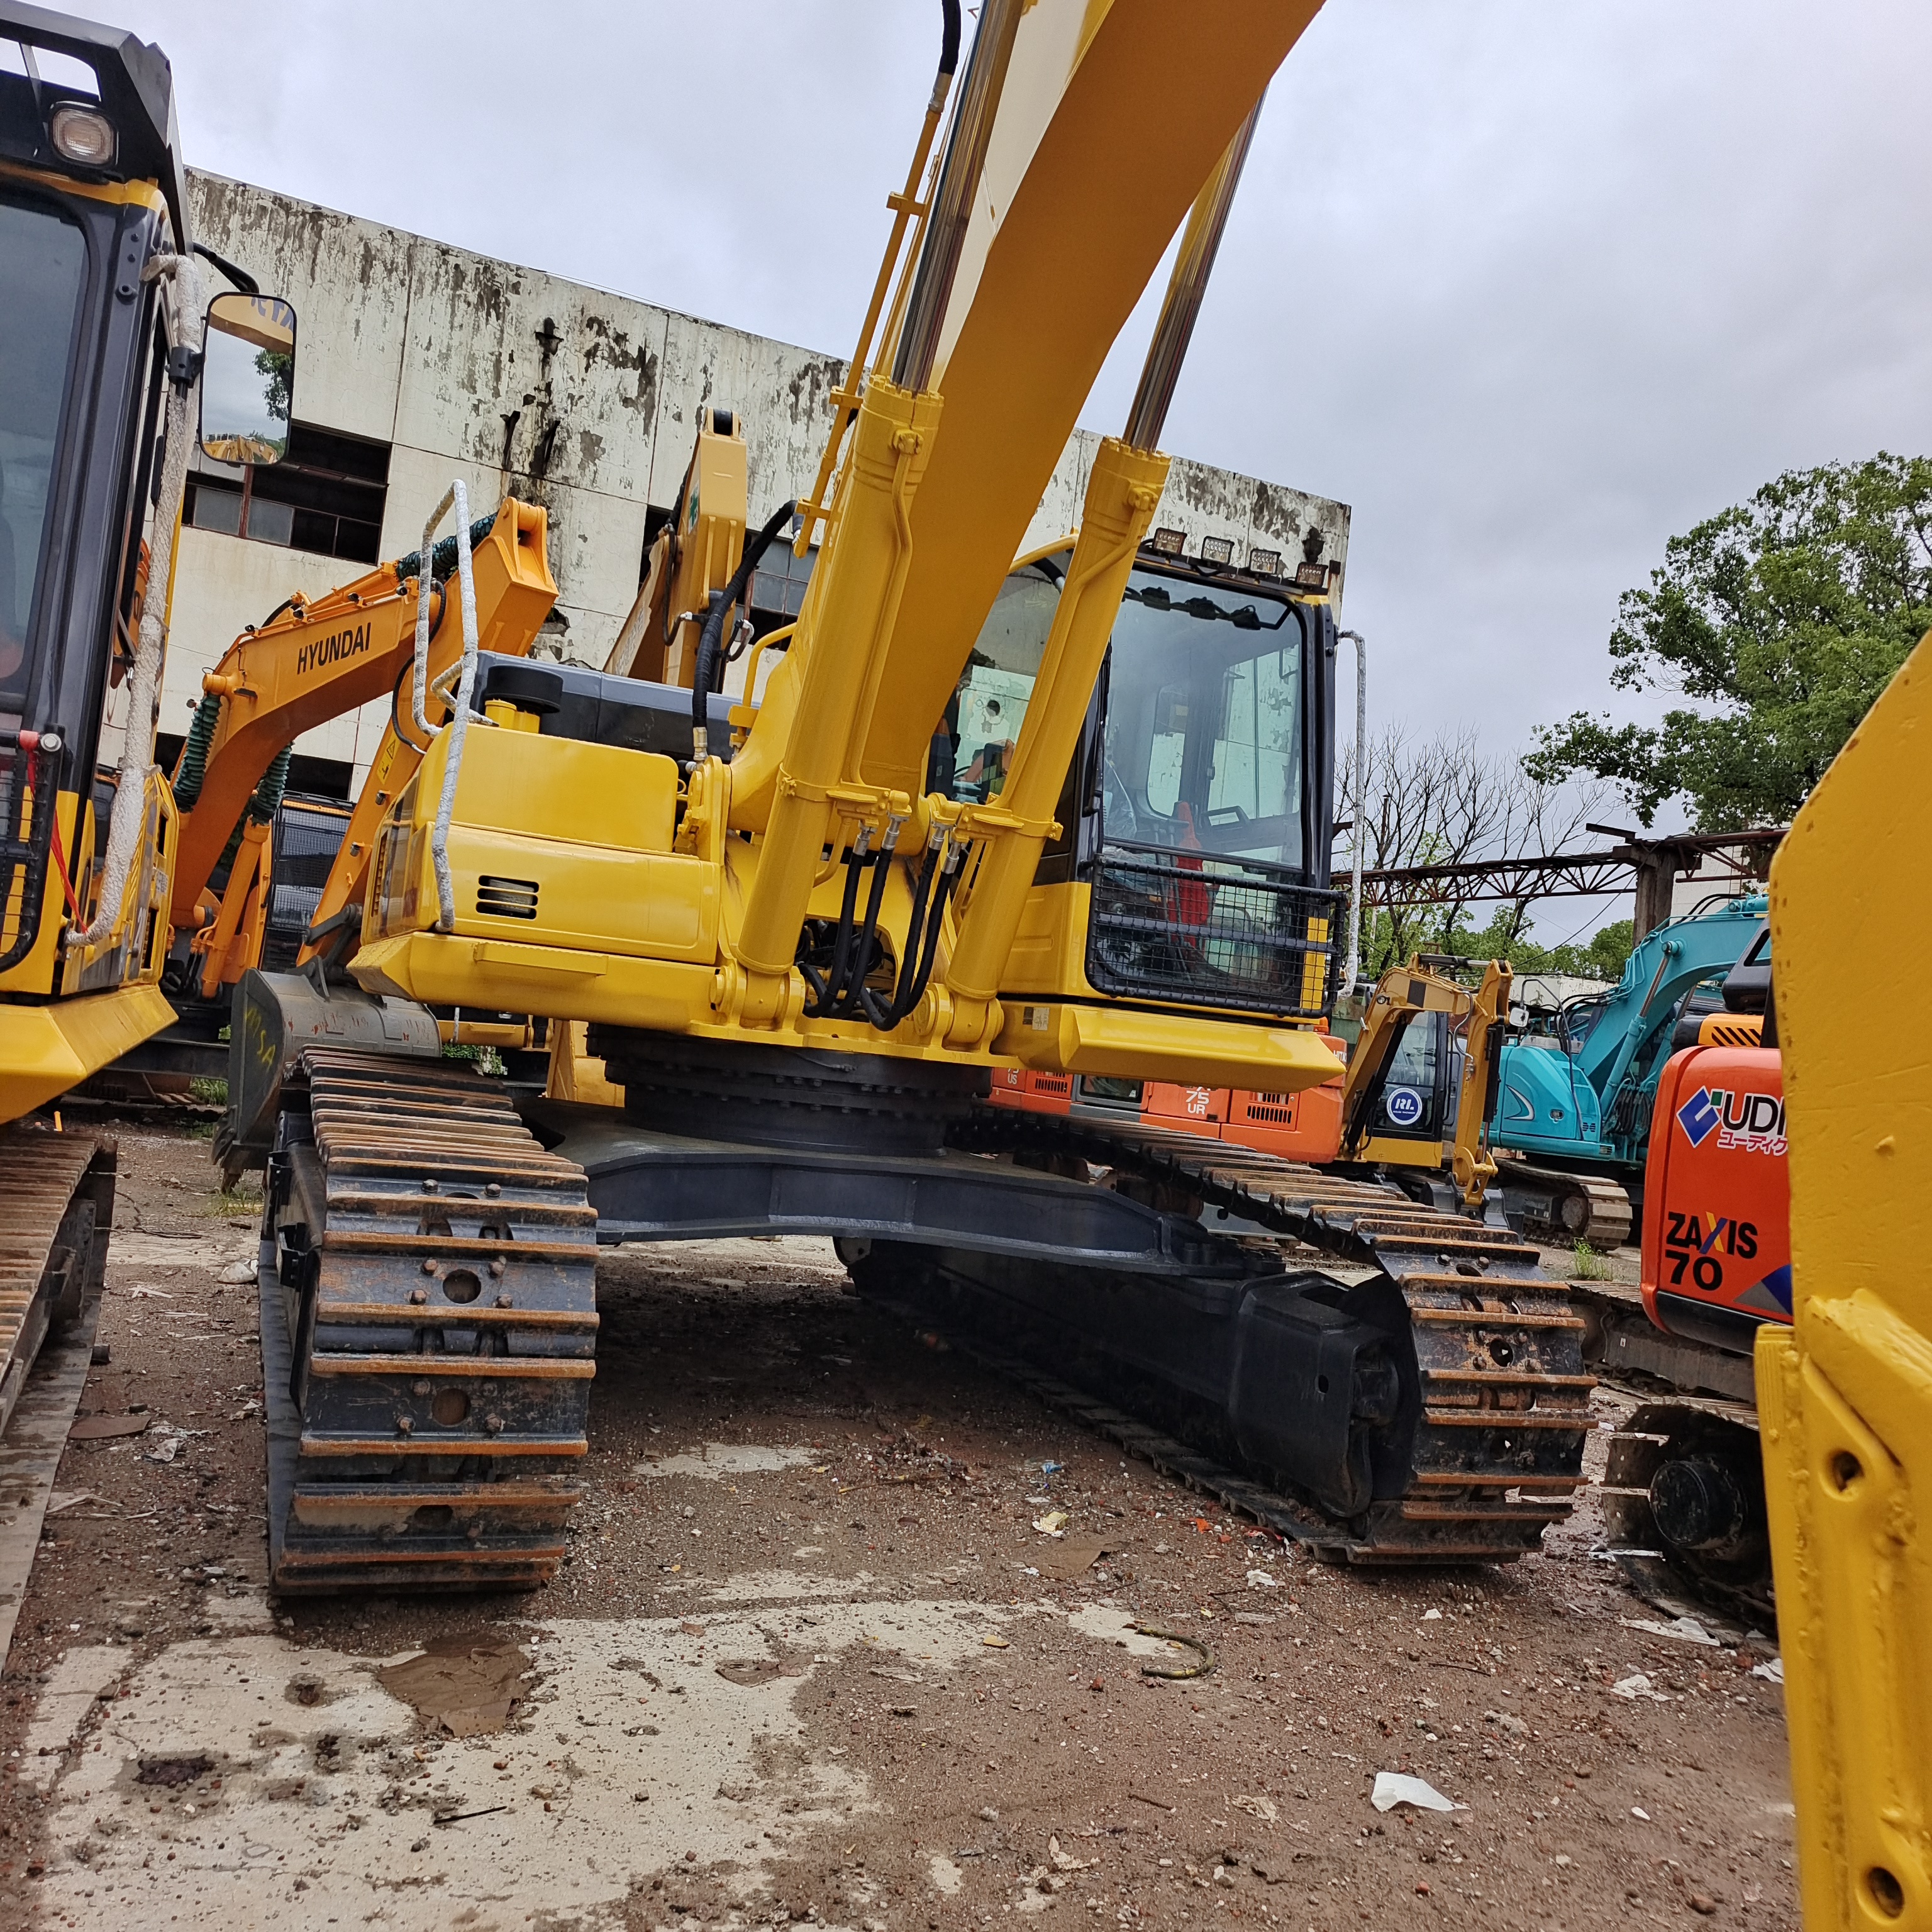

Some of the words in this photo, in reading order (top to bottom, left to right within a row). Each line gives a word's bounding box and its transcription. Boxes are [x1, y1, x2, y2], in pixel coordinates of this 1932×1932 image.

[297, 622, 371, 675] HYUNDAI
[1008, 1074, 1017, 1084] US
[1185, 1090, 1209, 1104] 75
[1187, 1103, 1206, 1115] UR
[1666, 1211, 1758, 1259] ZAXIS
[1665, 1249, 1723, 1291] 70
